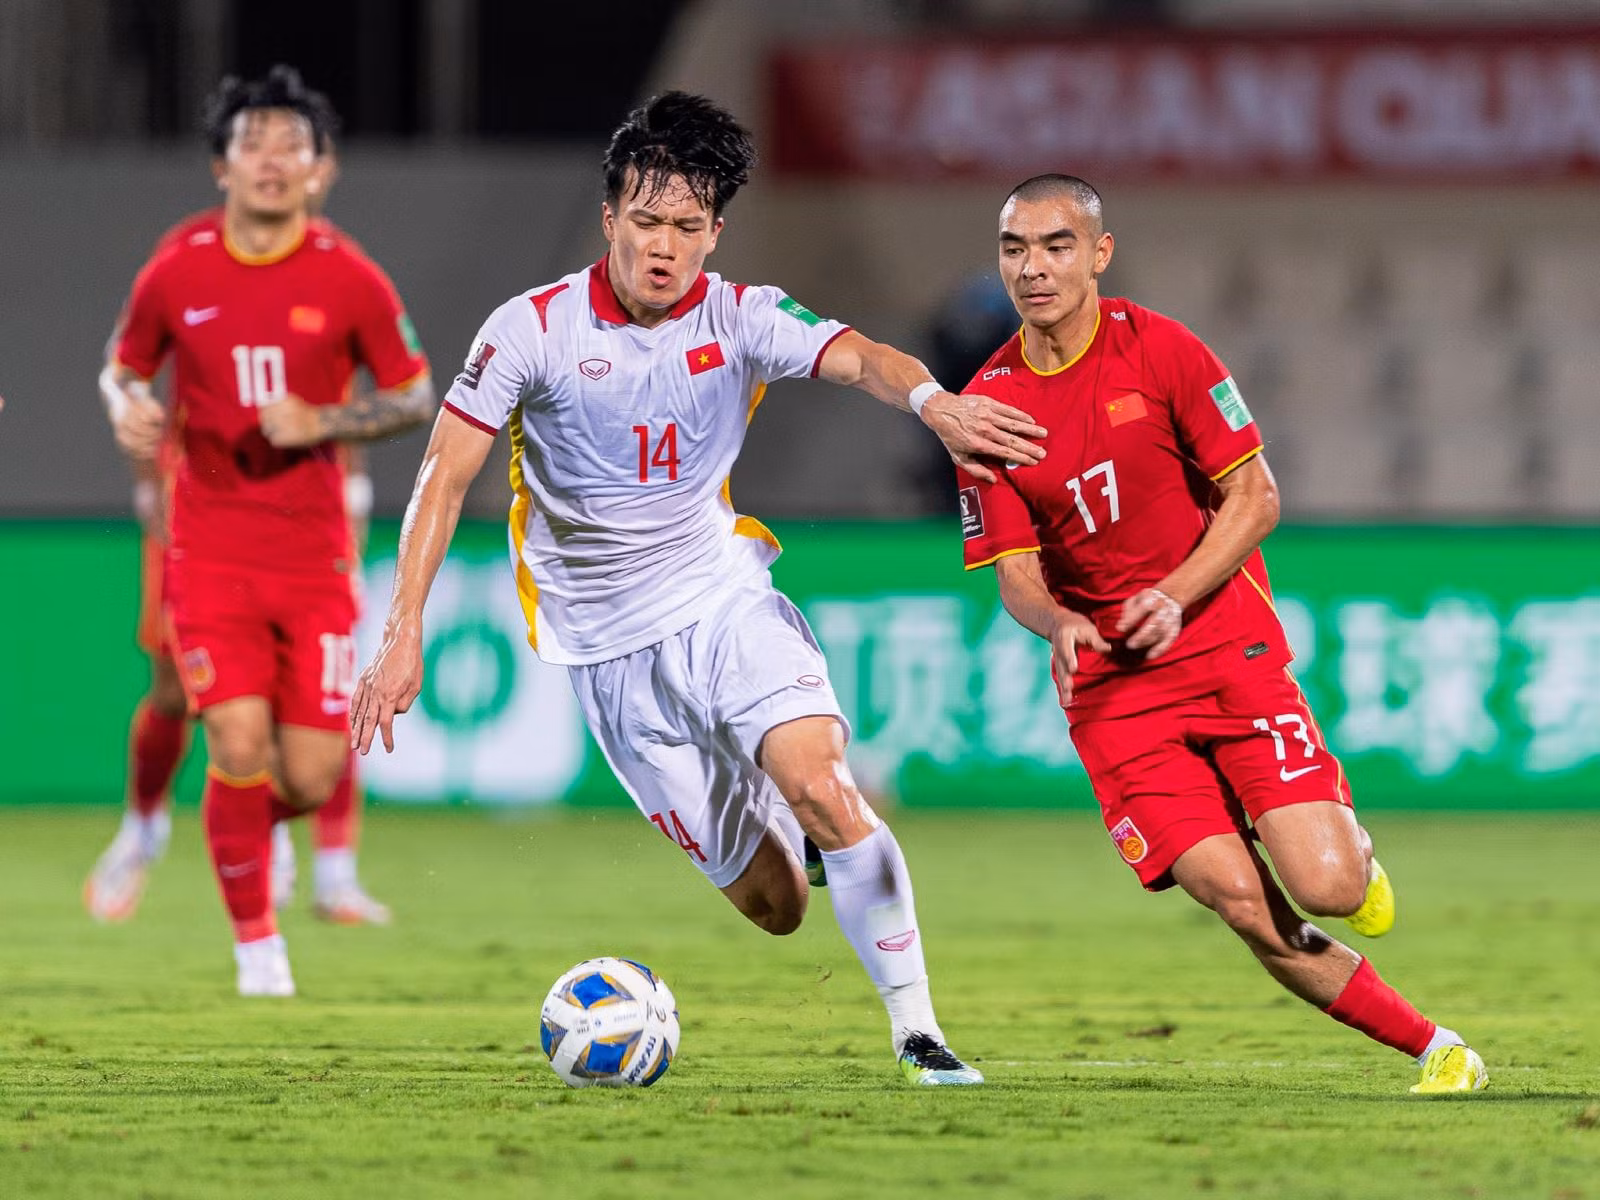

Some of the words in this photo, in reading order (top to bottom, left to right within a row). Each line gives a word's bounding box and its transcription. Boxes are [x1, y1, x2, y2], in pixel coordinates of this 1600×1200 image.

[231, 343, 288, 408] 10
[983, 366, 1012, 381] CFA
[632, 422, 682, 484] 14
[1065, 459, 1121, 534] 17
[1252, 713, 1316, 761] 17
[650, 809, 708, 864] 14
